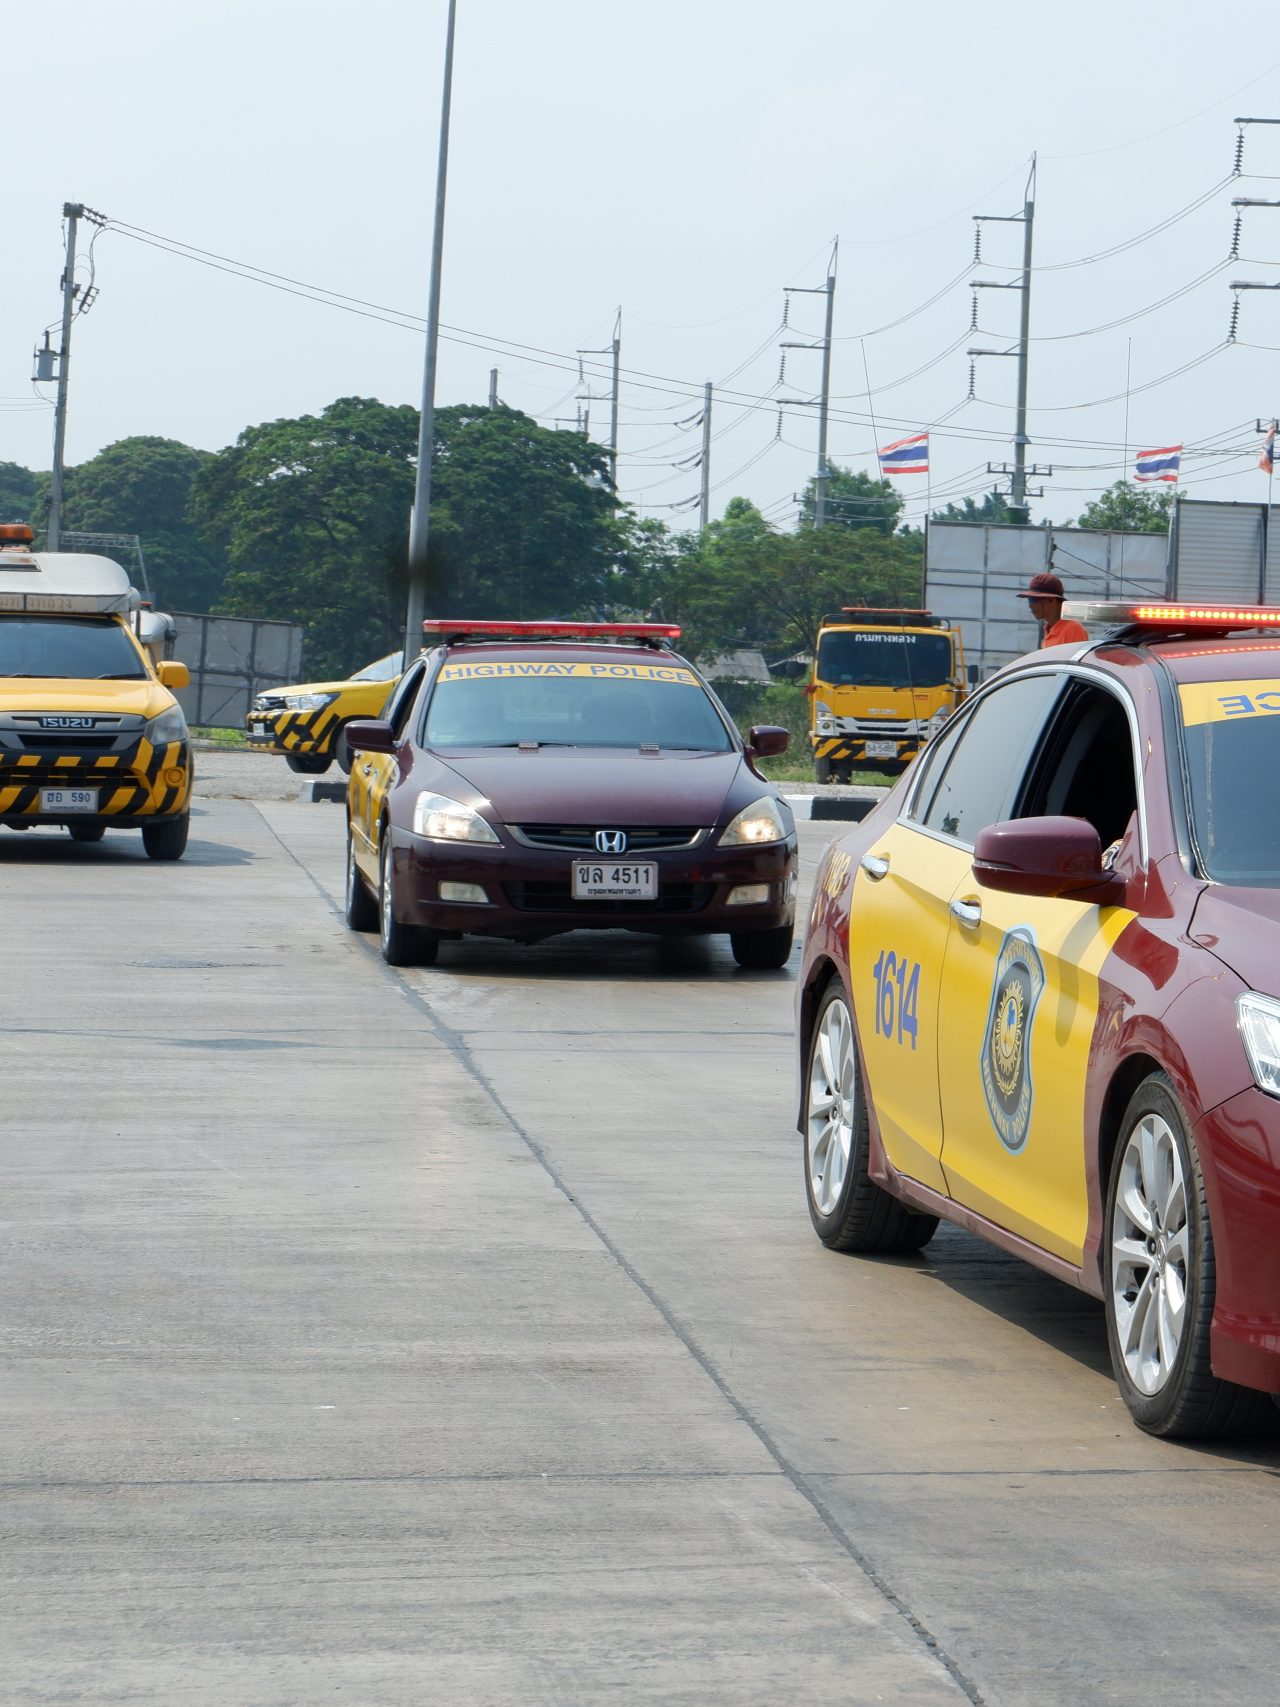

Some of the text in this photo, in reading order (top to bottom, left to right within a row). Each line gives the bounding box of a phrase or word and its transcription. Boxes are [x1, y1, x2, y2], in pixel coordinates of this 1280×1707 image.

[854, 633, 916, 644] กรมทางหลวง
[444, 664, 693, 683] HIGHWAY POLICE
[42, 717, 93, 728] ISUZU
[71, 792, 91, 803] 590
[611, 867, 650, 884] 4511
[873, 950, 921, 1051] 1614
